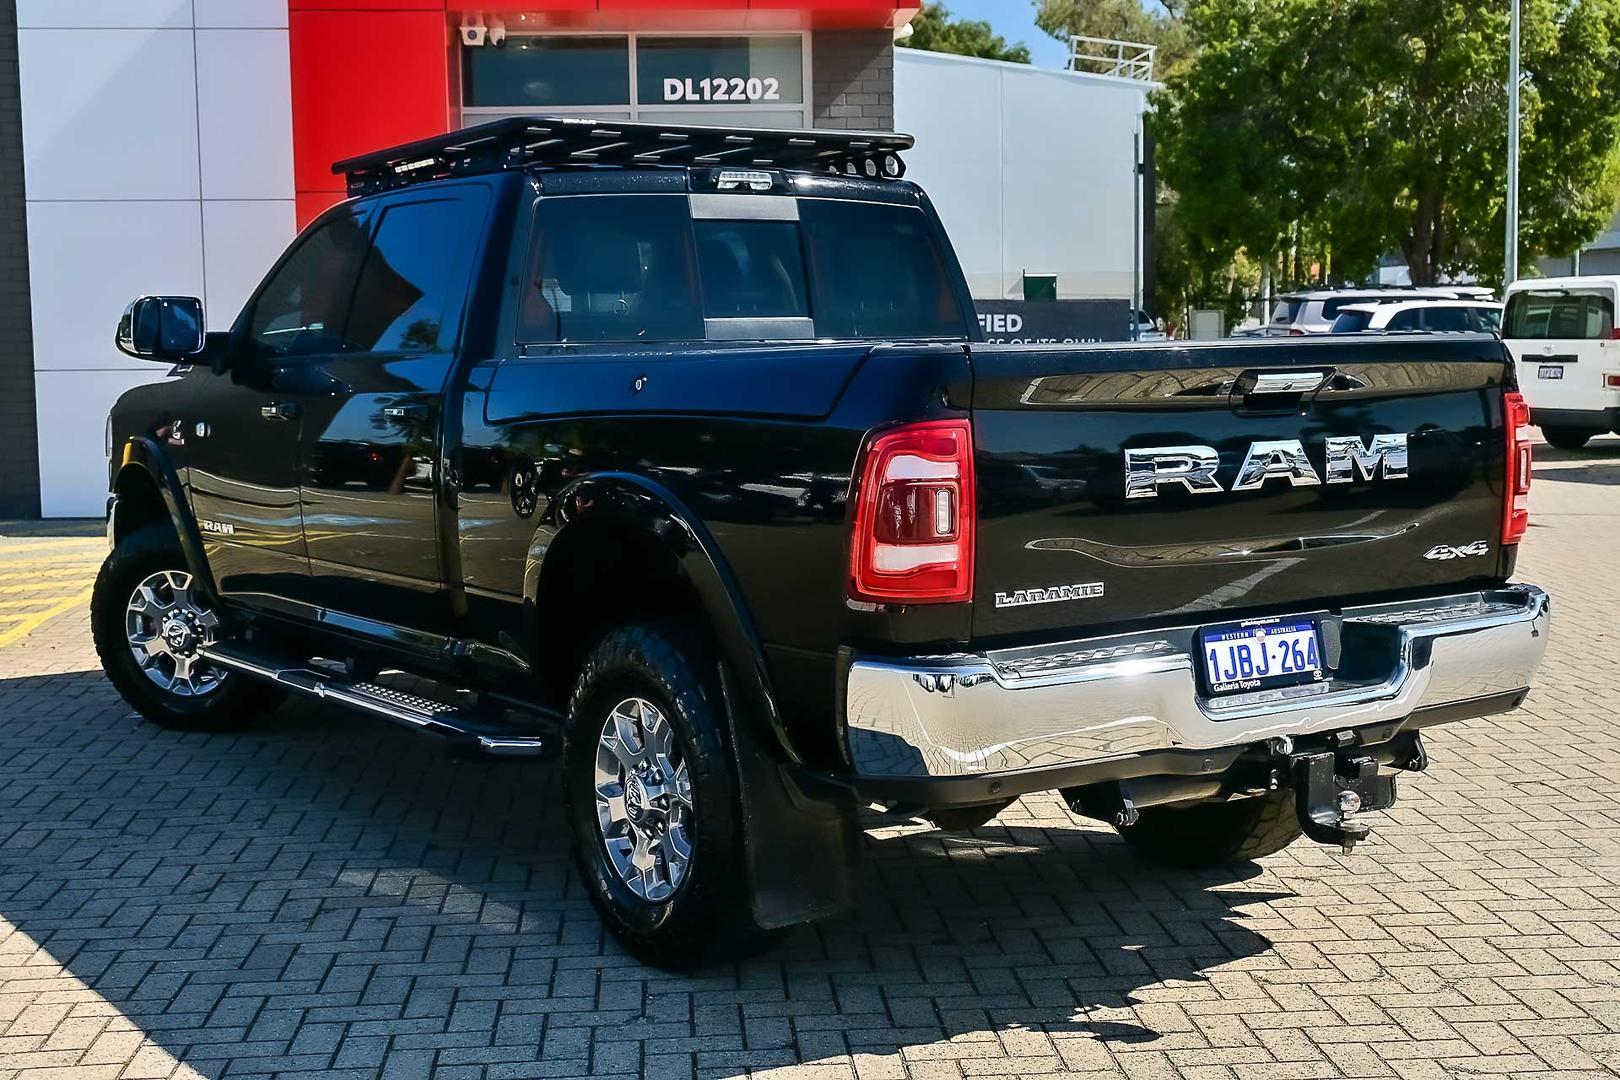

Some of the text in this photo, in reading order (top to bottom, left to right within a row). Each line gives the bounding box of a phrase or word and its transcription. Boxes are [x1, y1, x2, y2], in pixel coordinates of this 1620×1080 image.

[663, 77, 780, 101] DL12202
[1124, 432, 1409, 499] RAM
[203, 520, 235, 535] RAM
[994, 581, 1105, 608] LARAMIE
[1221, 625, 1297, 640] WESTERN AUSTRALIA
[1213, 679, 1261, 692] Galleria Toyota
